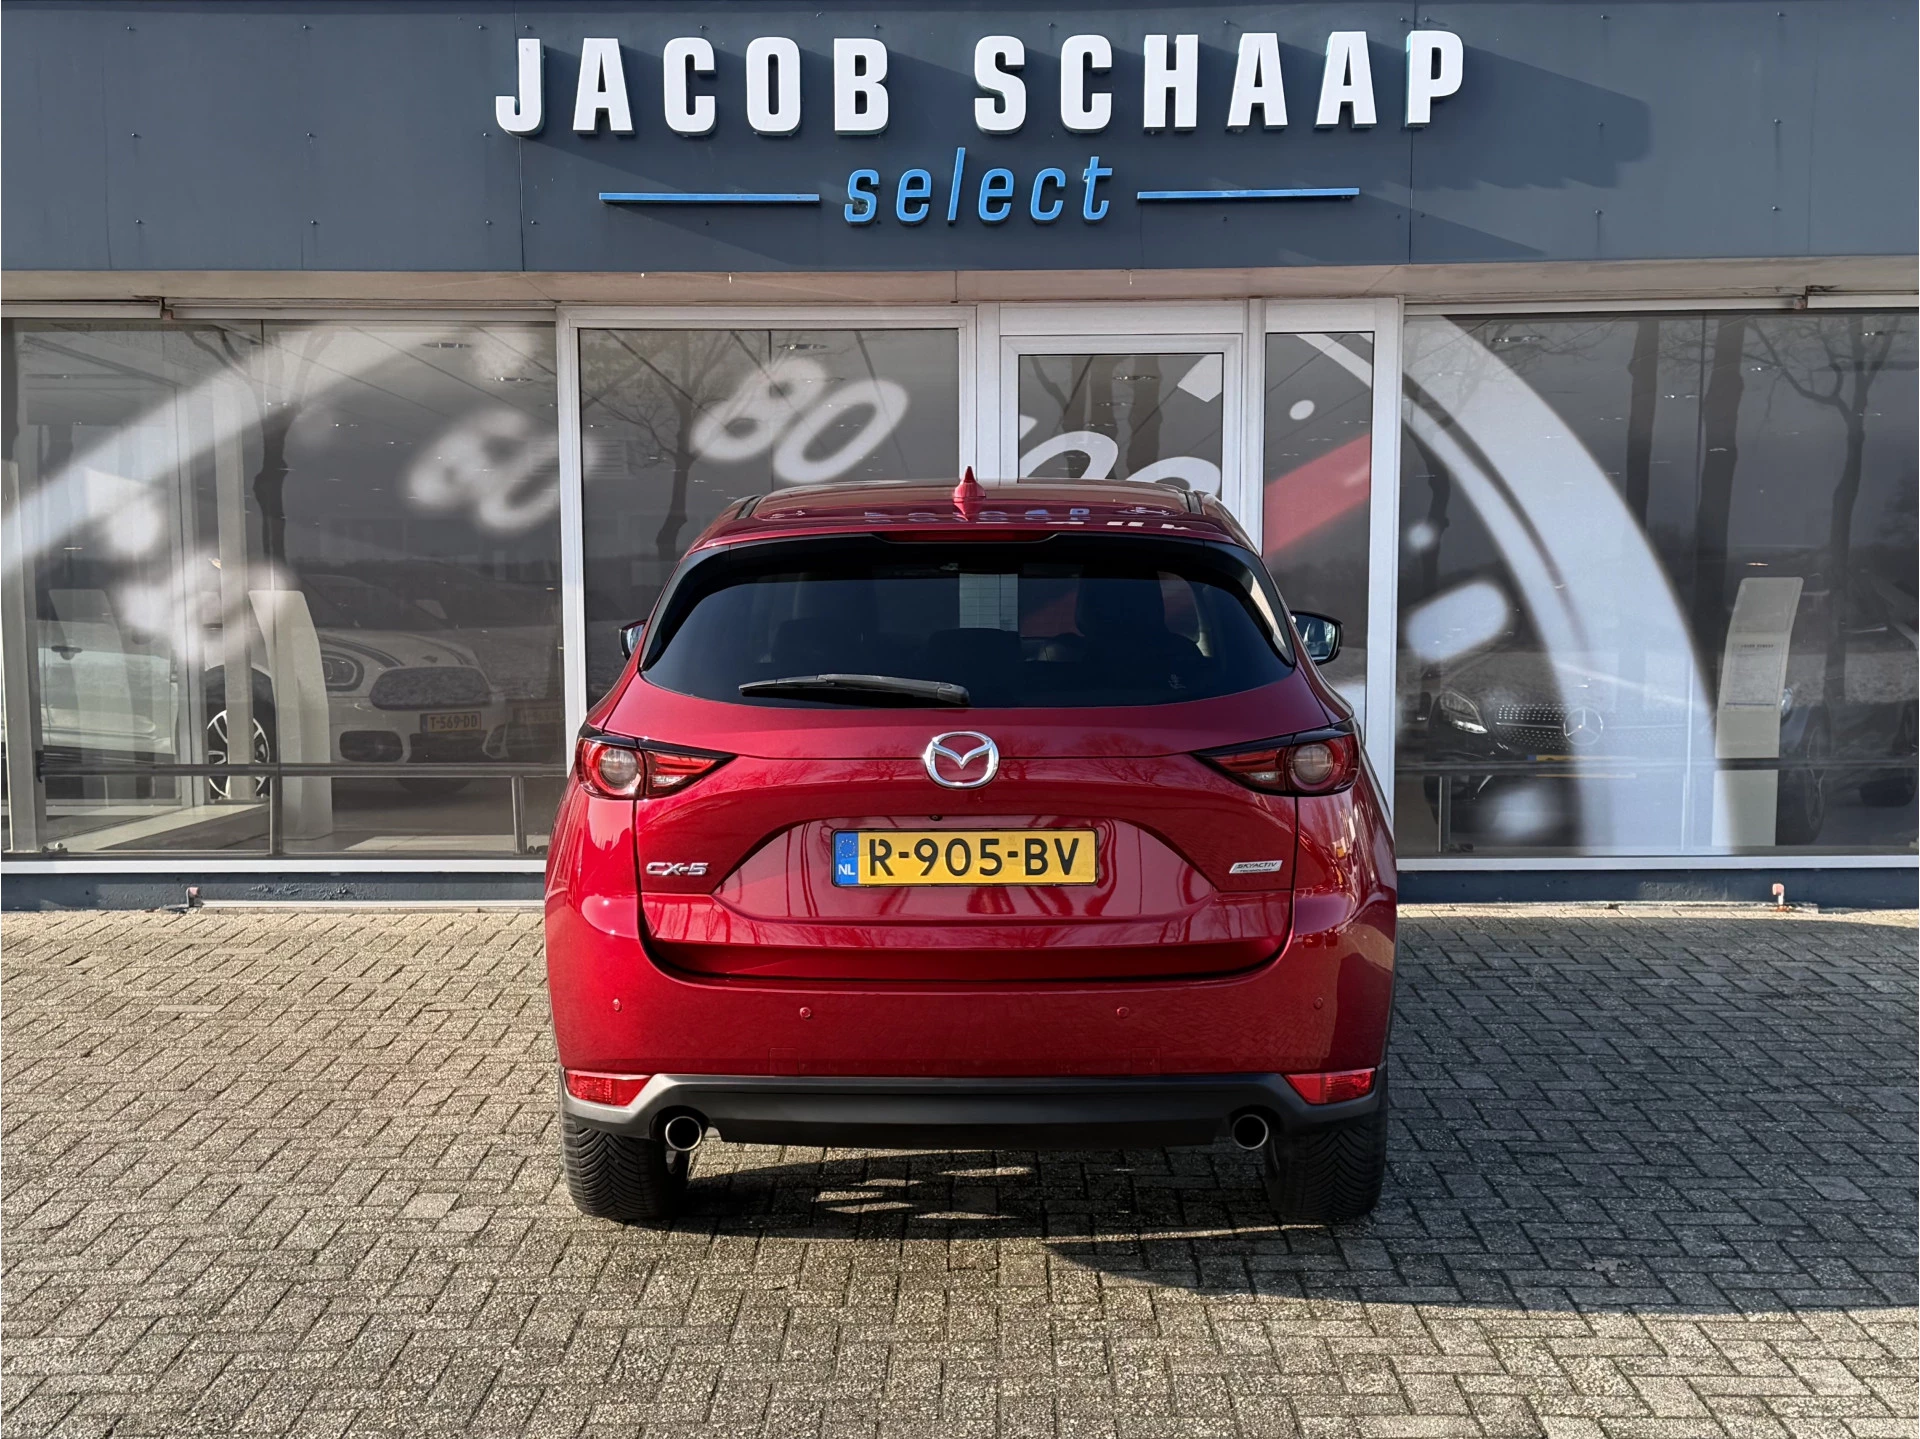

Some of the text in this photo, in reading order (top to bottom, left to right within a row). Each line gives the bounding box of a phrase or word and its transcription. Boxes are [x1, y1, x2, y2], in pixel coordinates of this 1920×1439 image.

[495, 30, 1465, 136] JACOB SCHAAP
[843, 147, 1113, 224] select
[690, 356, 909, 483] 80
[429, 715, 478, 730] T-569-DD
[646, 861, 709, 876] CX-5
[838, 837, 1080, 877] NL R-905-BV
